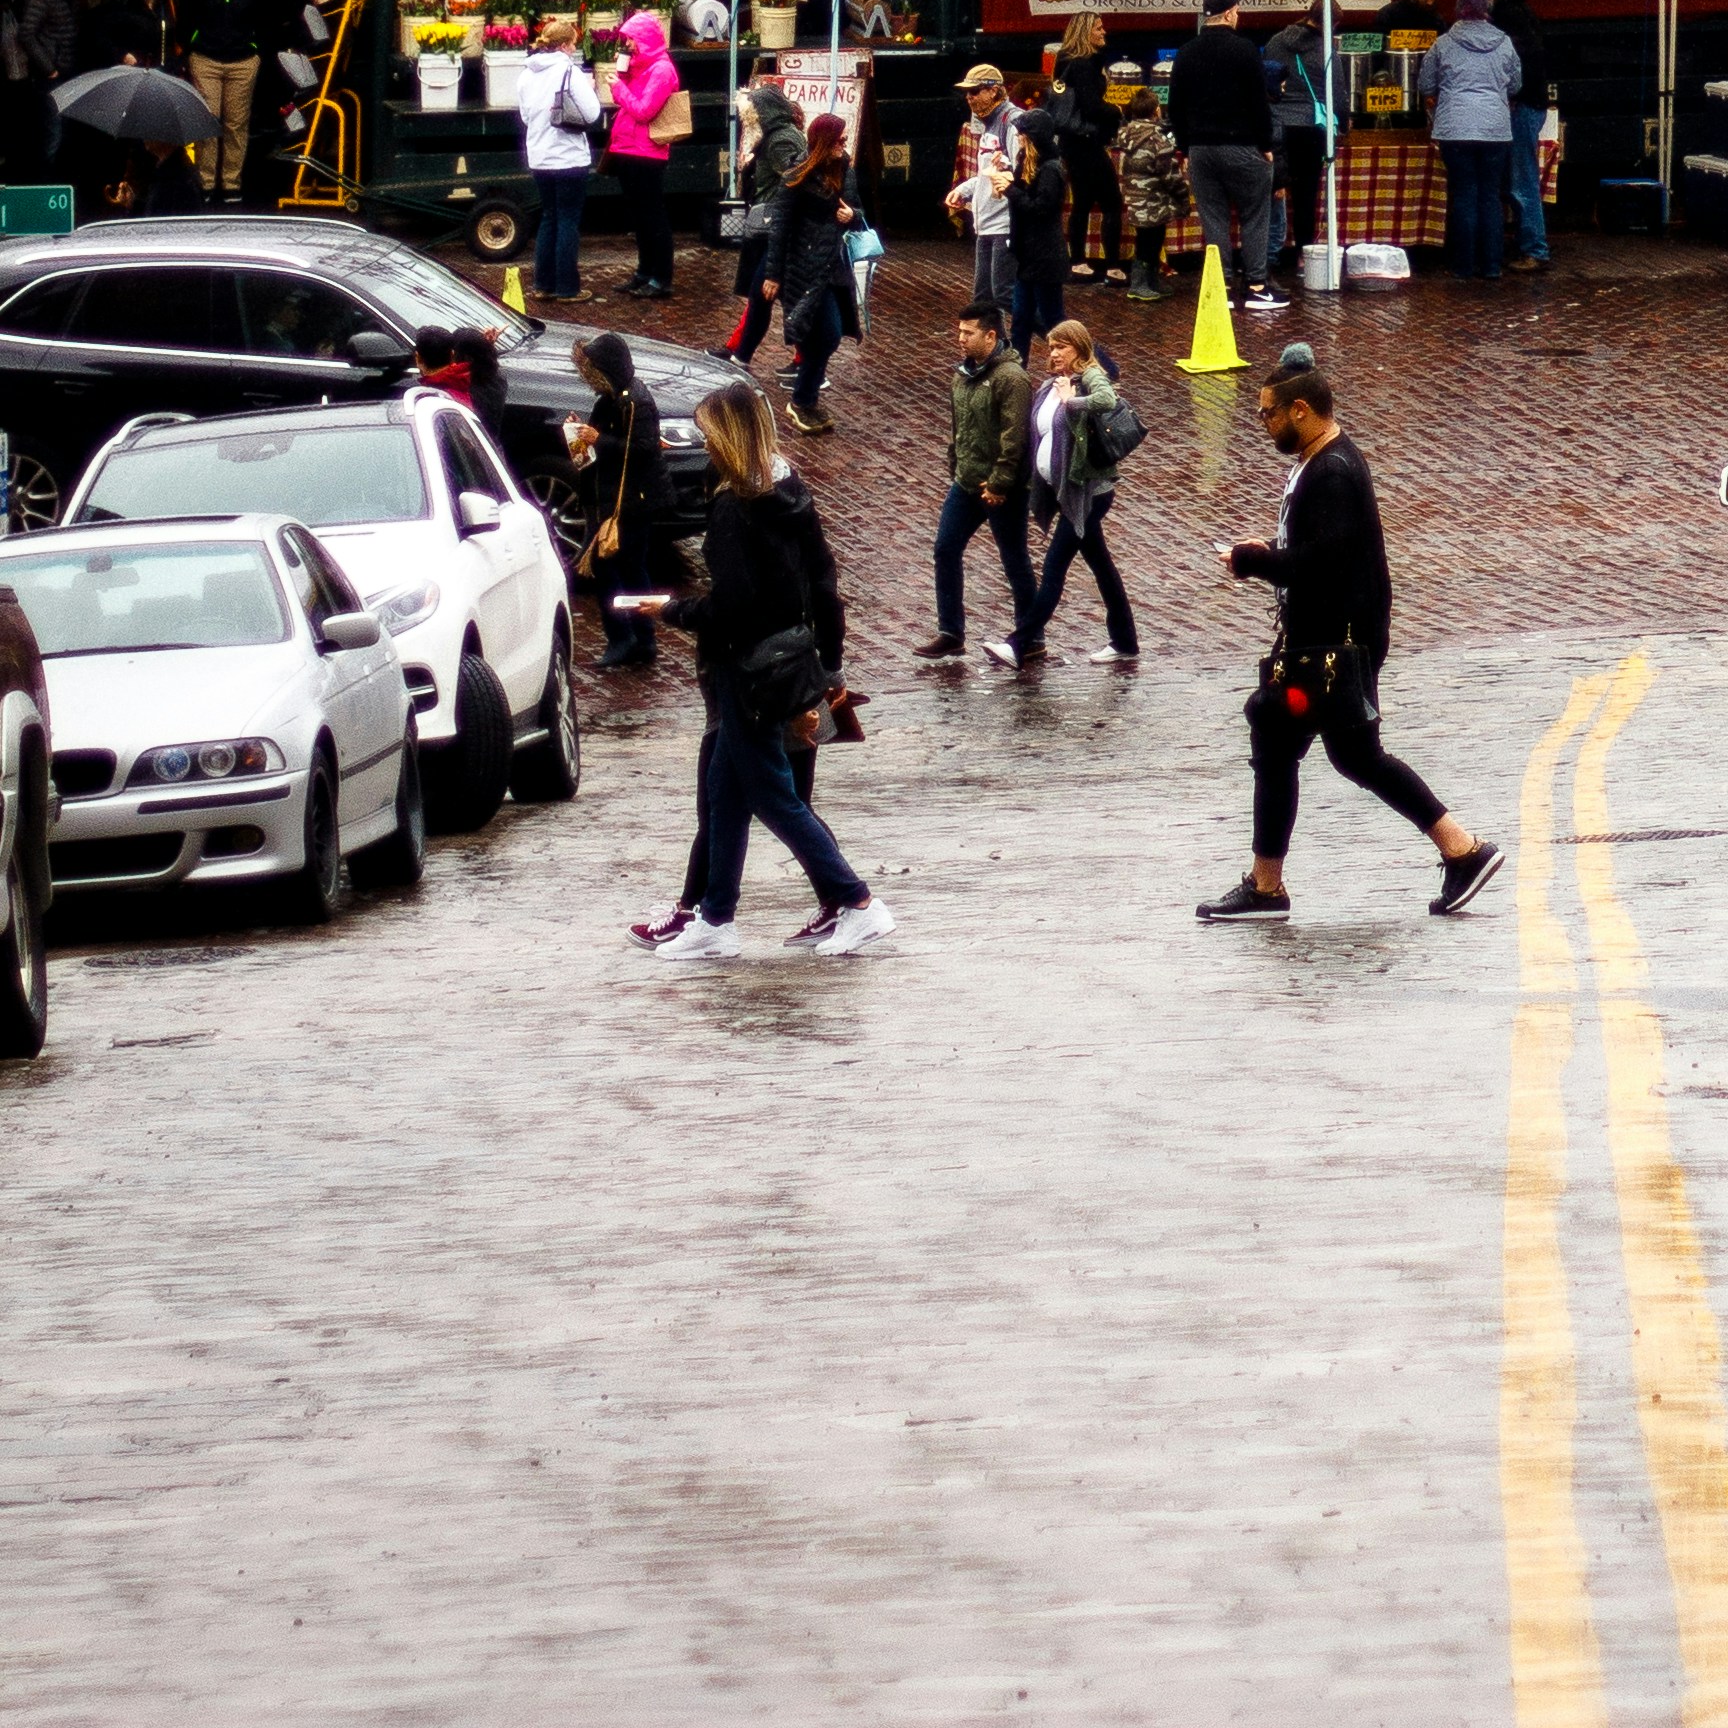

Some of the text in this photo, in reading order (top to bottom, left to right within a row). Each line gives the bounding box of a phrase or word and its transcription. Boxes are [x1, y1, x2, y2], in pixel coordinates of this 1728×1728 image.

[787, 84, 857, 104] PARKNG
[1369, 94, 1398, 106] TIPS
[49, 193, 68, 210] 60
